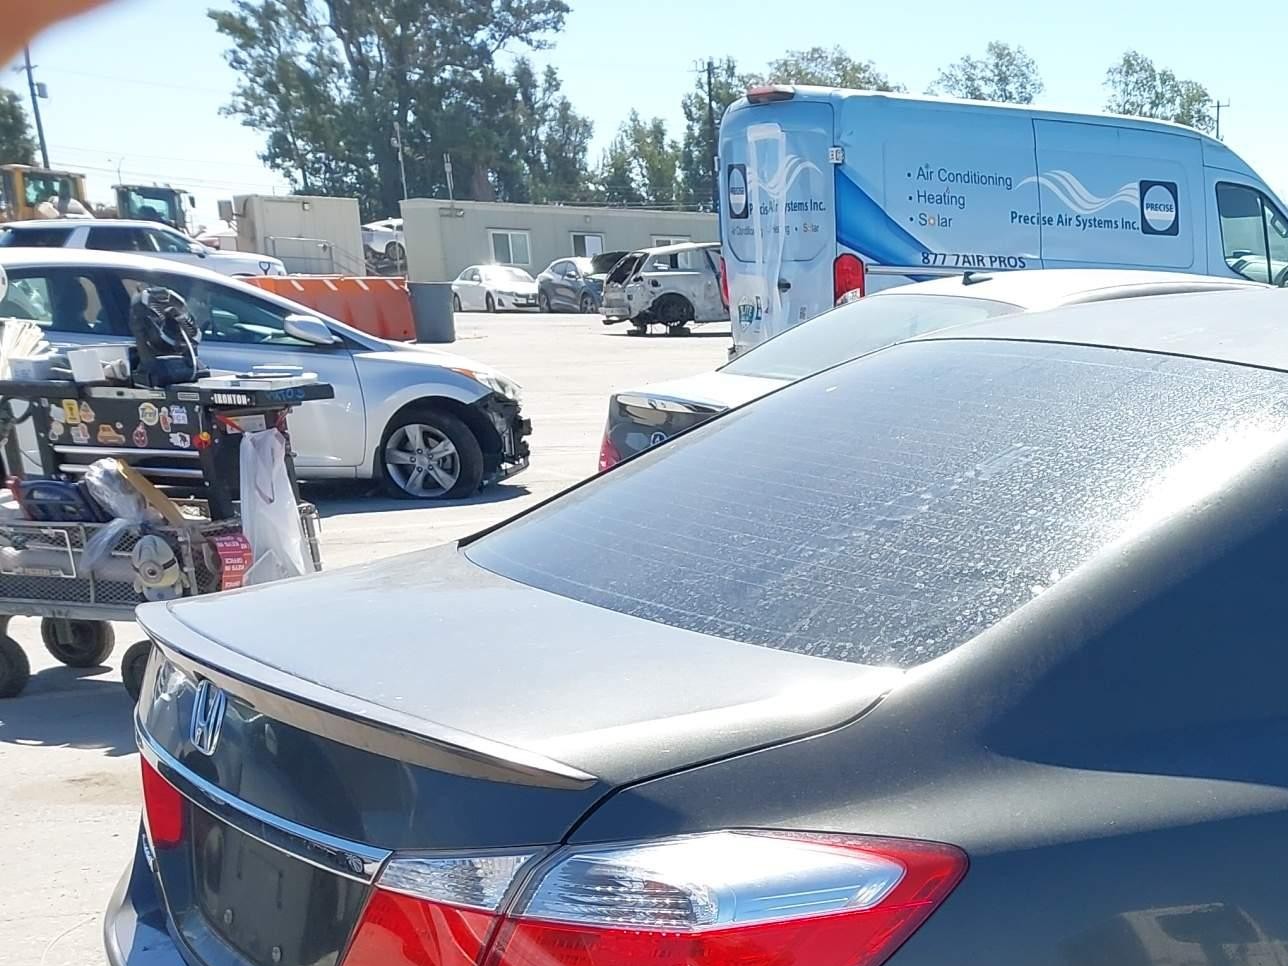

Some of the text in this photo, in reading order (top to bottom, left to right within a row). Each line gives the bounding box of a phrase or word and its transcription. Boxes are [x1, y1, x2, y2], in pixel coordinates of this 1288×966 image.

[916, 166, 1013, 190] Air Conditioning
[810, 199, 827, 211] Inc.
[917, 190, 966, 209] Heating
[1146, 202, 1174, 213] PRECISE
[918, 212, 953, 227] Solar
[1010, 211, 1140, 231] Precise Air Systems Inc.
[921, 251, 1026, 269] 877 7AIR PROS
